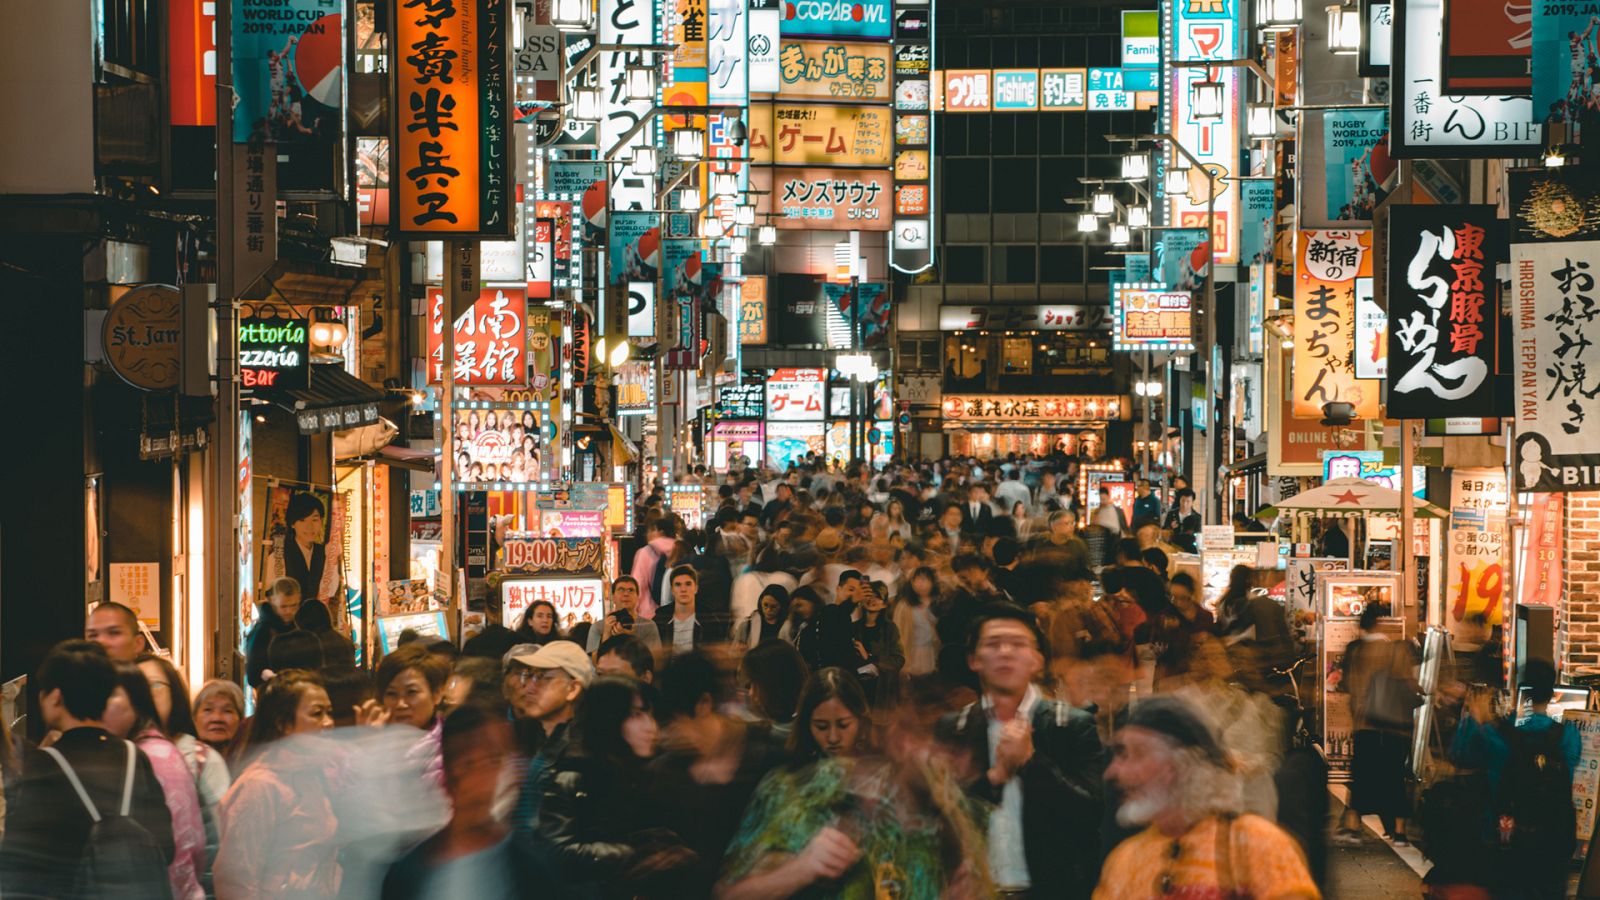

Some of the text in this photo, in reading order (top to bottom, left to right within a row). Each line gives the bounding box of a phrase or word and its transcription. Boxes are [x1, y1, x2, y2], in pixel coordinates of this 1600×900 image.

[243, 9, 325, 20] WORLD CUP
[1543, 5, 1578, 17] 2019,
[243, 22, 325, 35] 2019, JAPAN
[779, 44, 886, 84] まんが喫茶
[996, 76, 1036, 105] Fishing
[1044, 74, 1084, 106] 釣具
[1095, 94, 1129, 108] 免税
[1411, 78, 1434, 142] 一番街
[1332, 120, 1366, 129] RUGBY
[1332, 129, 1389, 138] WORLD CUP
[1494, 121, 1537, 141] B1F
[778, 123, 848, 153] ゲーム
[1332, 139, 1357, 148] 2019,
[782, 180, 881, 204] メンズサウナ
[1308, 239, 1360, 268] 新宿
[1325, 266, 1343, 280] の
[1450, 222, 1486, 356] 東京豚骨
[1518, 260, 1536, 330] HIROSHIMA
[1127, 328, 1190, 337] PRIVATE ROOM
[1303, 284, 1342, 402] まっちゃん
[1545, 257, 1600, 435] お好み焼き
[453, 340, 521, 383] 菜館
[242, 368, 279, 388] Bar
[771, 393, 822, 412] ゲーム
[1288, 431, 1328, 444] ONLINE
[1277, 507, 1402, 519] Heineke
[505, 540, 557, 567] 19:00
[557, 538, 600, 567] オープン
